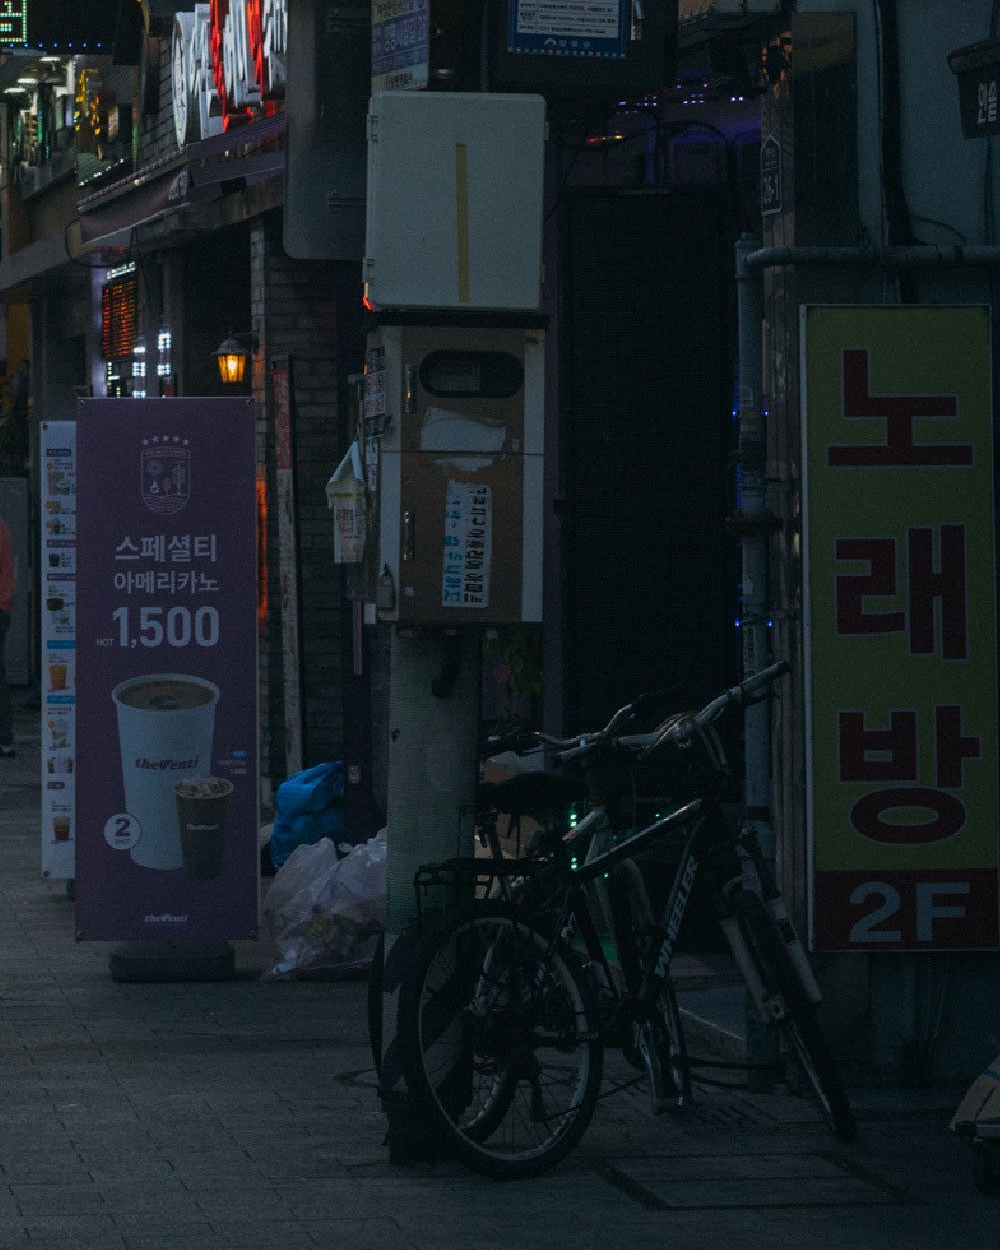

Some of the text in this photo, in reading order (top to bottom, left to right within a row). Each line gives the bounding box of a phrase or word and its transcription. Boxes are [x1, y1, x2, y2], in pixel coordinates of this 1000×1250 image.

[115, 534, 217, 562] 스페셜티
[114, 570, 220, 594] 아메리카노
[826, 348, 982, 846] 노래방
[112, 606, 220, 649] 1,500
[115, 818, 131, 837] 2
[848, 880, 971, 944] 2F
